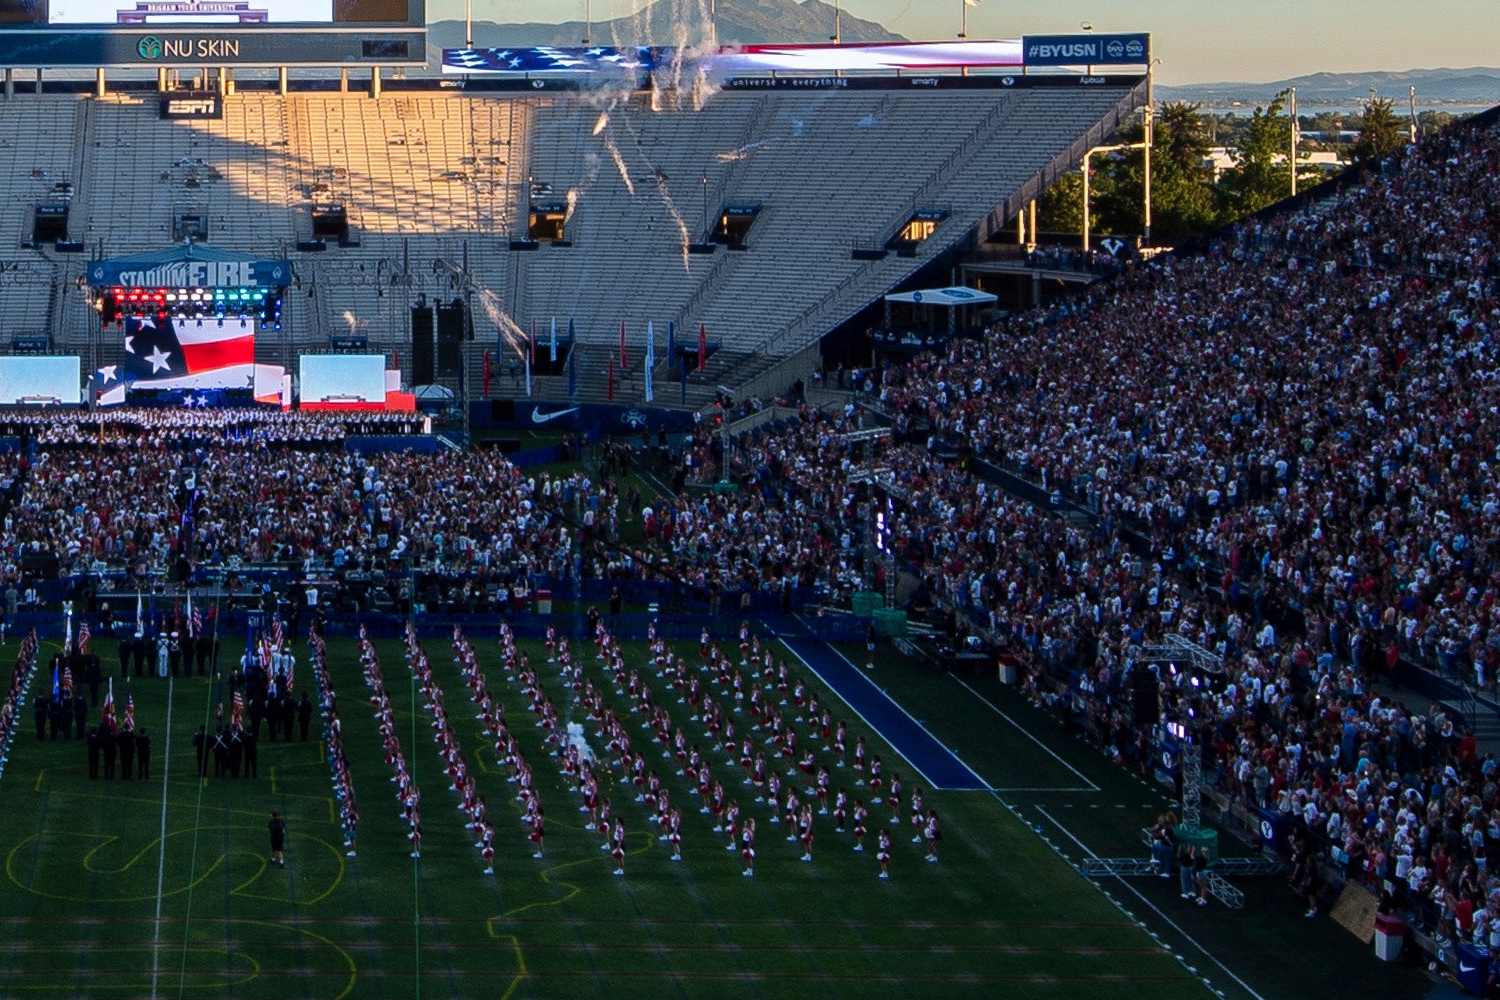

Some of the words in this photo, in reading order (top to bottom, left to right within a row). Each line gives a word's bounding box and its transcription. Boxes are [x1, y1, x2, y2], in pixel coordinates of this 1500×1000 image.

[164, 40, 193, 57] NU
[197, 40, 239, 57] SKIN
[1028, 44, 1096, 58] #BYUSN
[793, 79, 848, 87] everything
[168, 100, 215, 114] ESPN
[119, 264, 188, 287] STADIUM
[189, 261, 258, 287] FIRE
